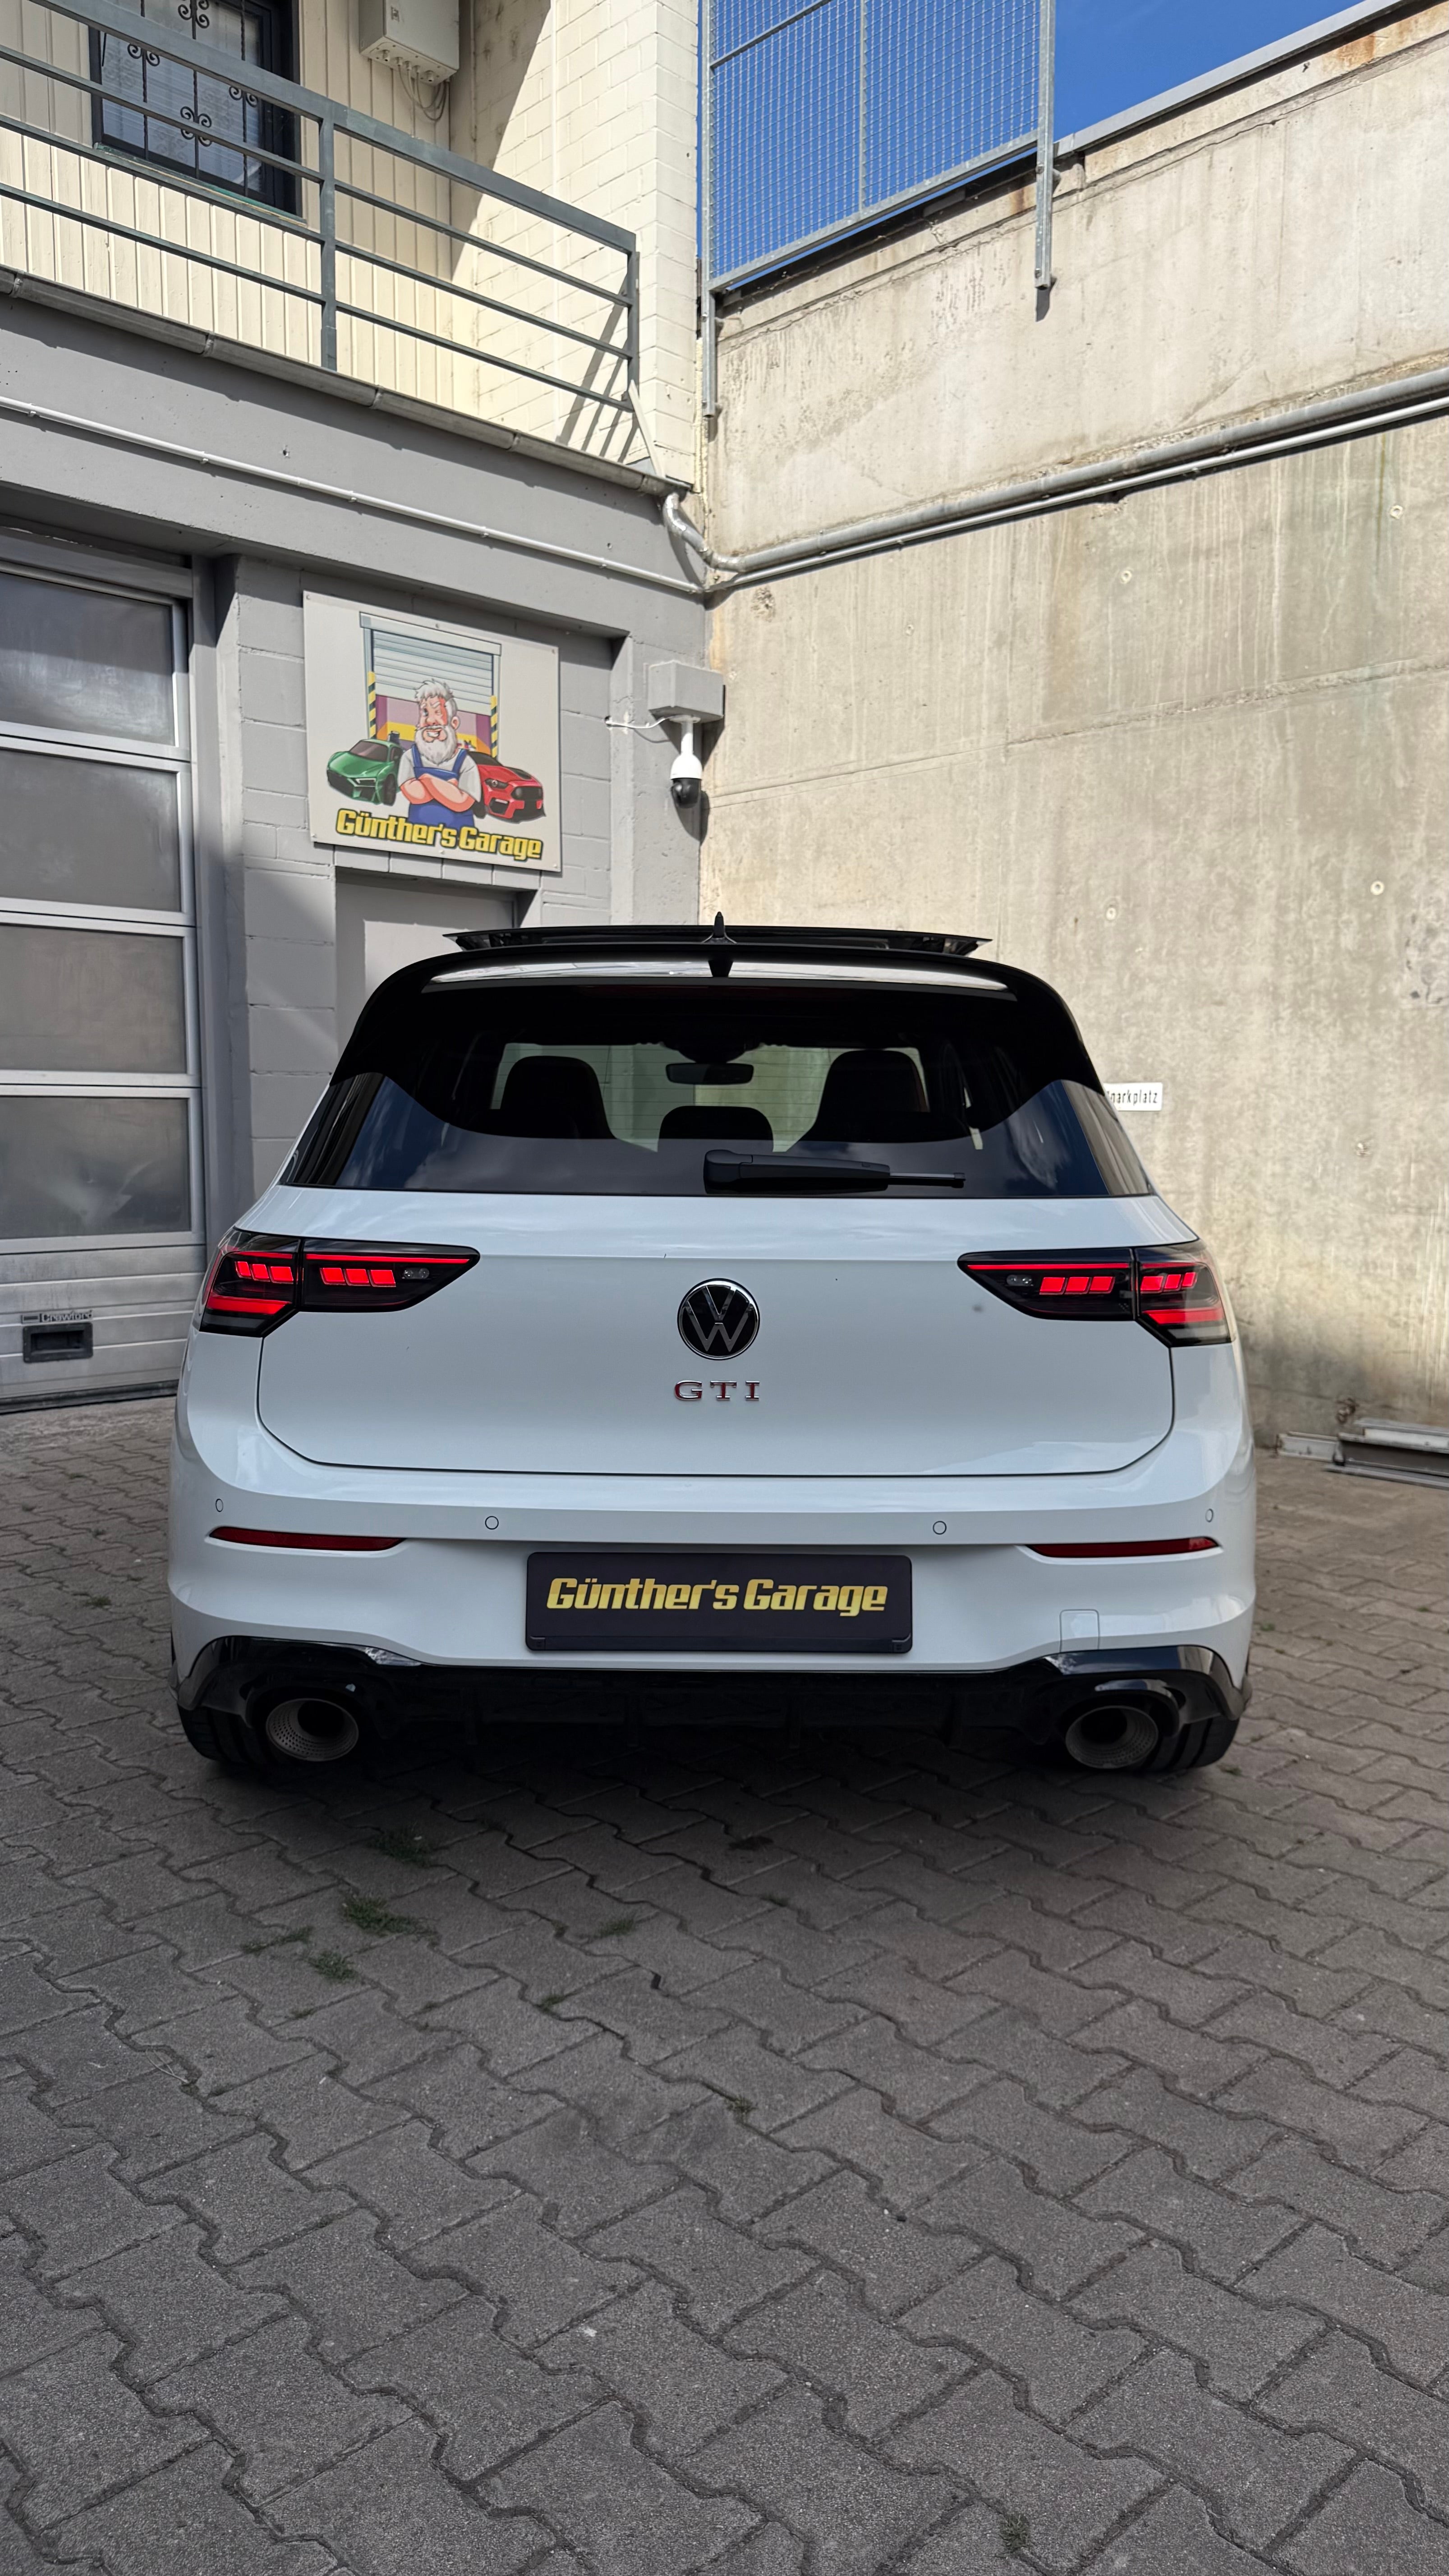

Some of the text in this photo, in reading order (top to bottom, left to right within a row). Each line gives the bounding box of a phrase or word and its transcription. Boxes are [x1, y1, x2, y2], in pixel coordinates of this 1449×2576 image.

[336, 809, 542, 861] Günther's Garage
[675, 1380, 760, 1401] GTI
[547, 1578, 888, 1617] Günther's Garage
